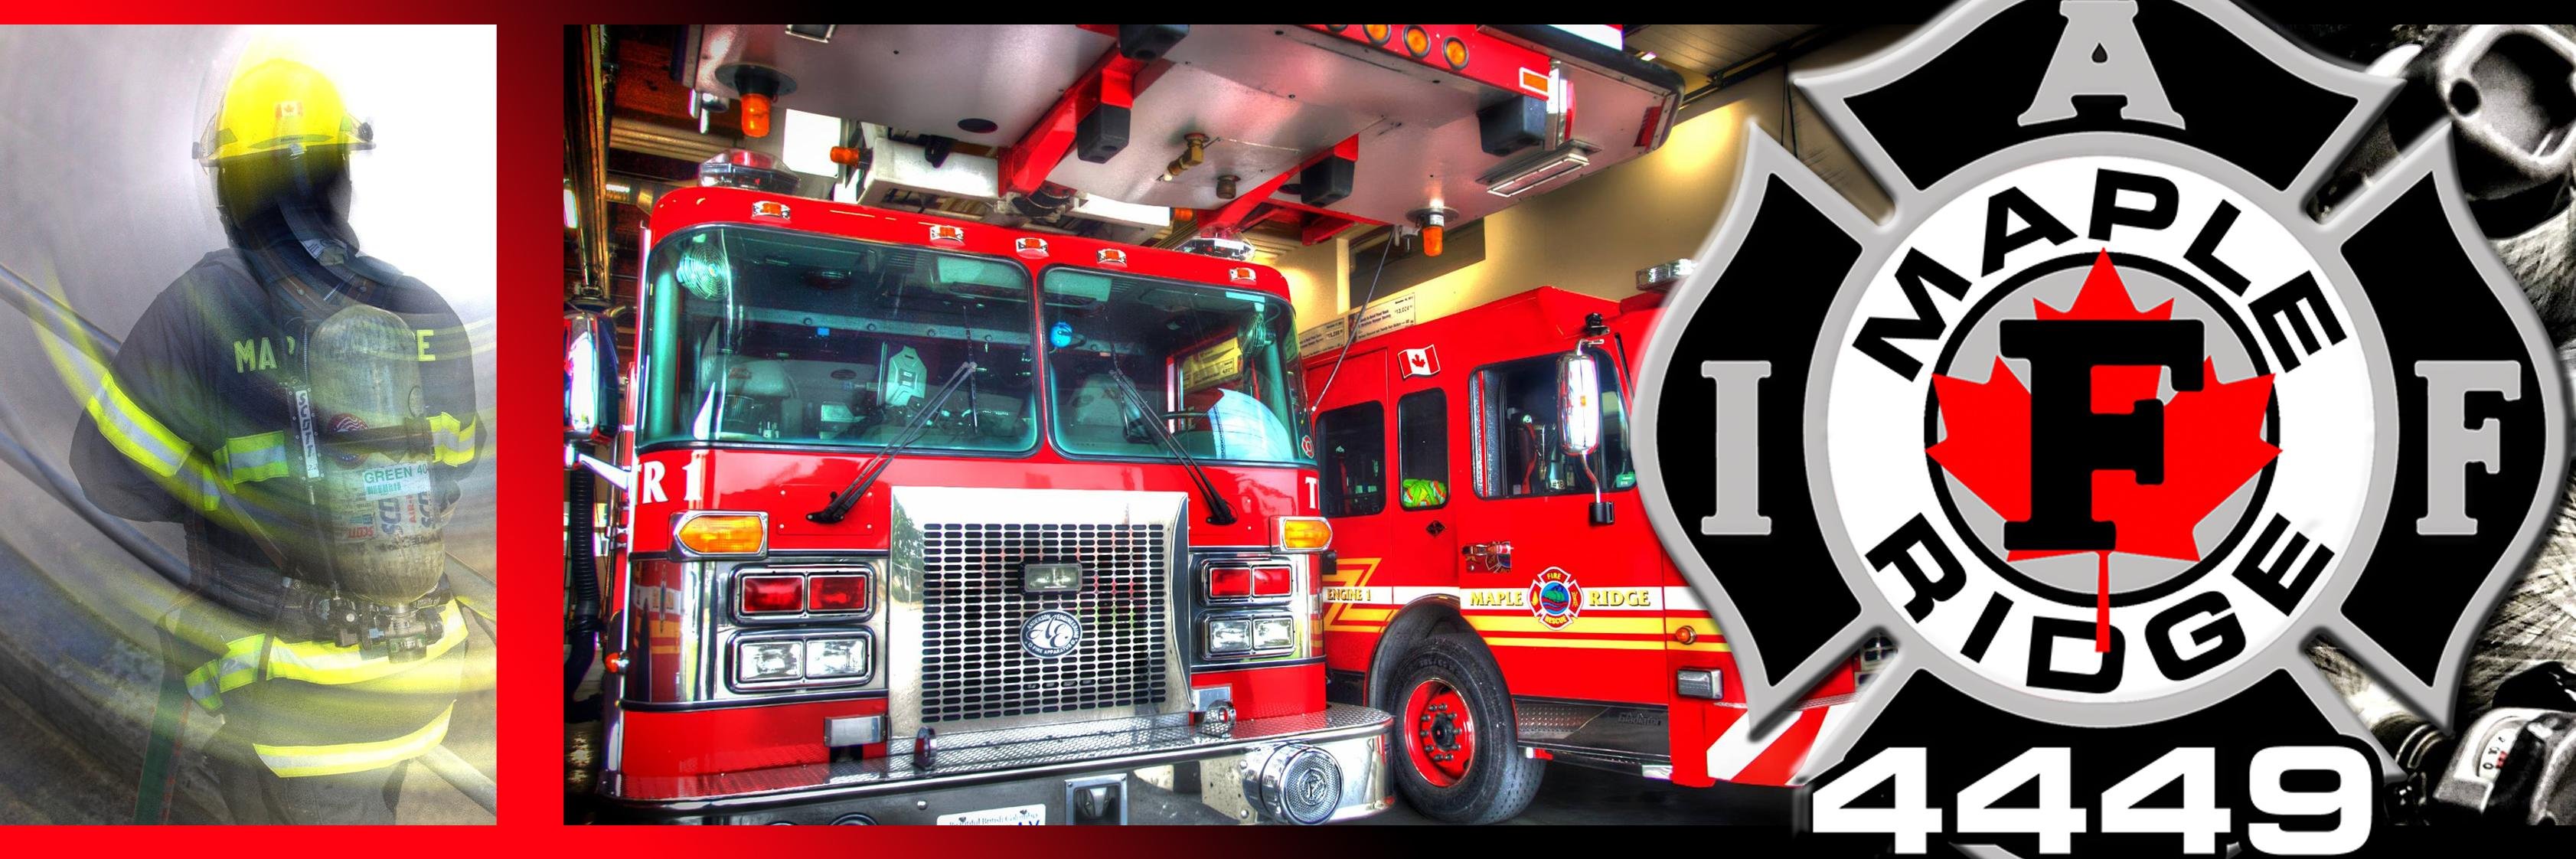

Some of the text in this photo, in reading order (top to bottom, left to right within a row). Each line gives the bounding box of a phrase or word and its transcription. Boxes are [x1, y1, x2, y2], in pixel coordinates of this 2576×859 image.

[364, 466, 413, 484] GREEN
[1327, 589, 1371, 601] ENGINE 1
[1471, 590, 1650, 606] MAPLE RIDGE
[1027, 614, 1051, 629] ANDERSON
[1545, 615, 1567, 625] RESCUE
[1032, 642, 1072, 655] FIRE APPARATUS
